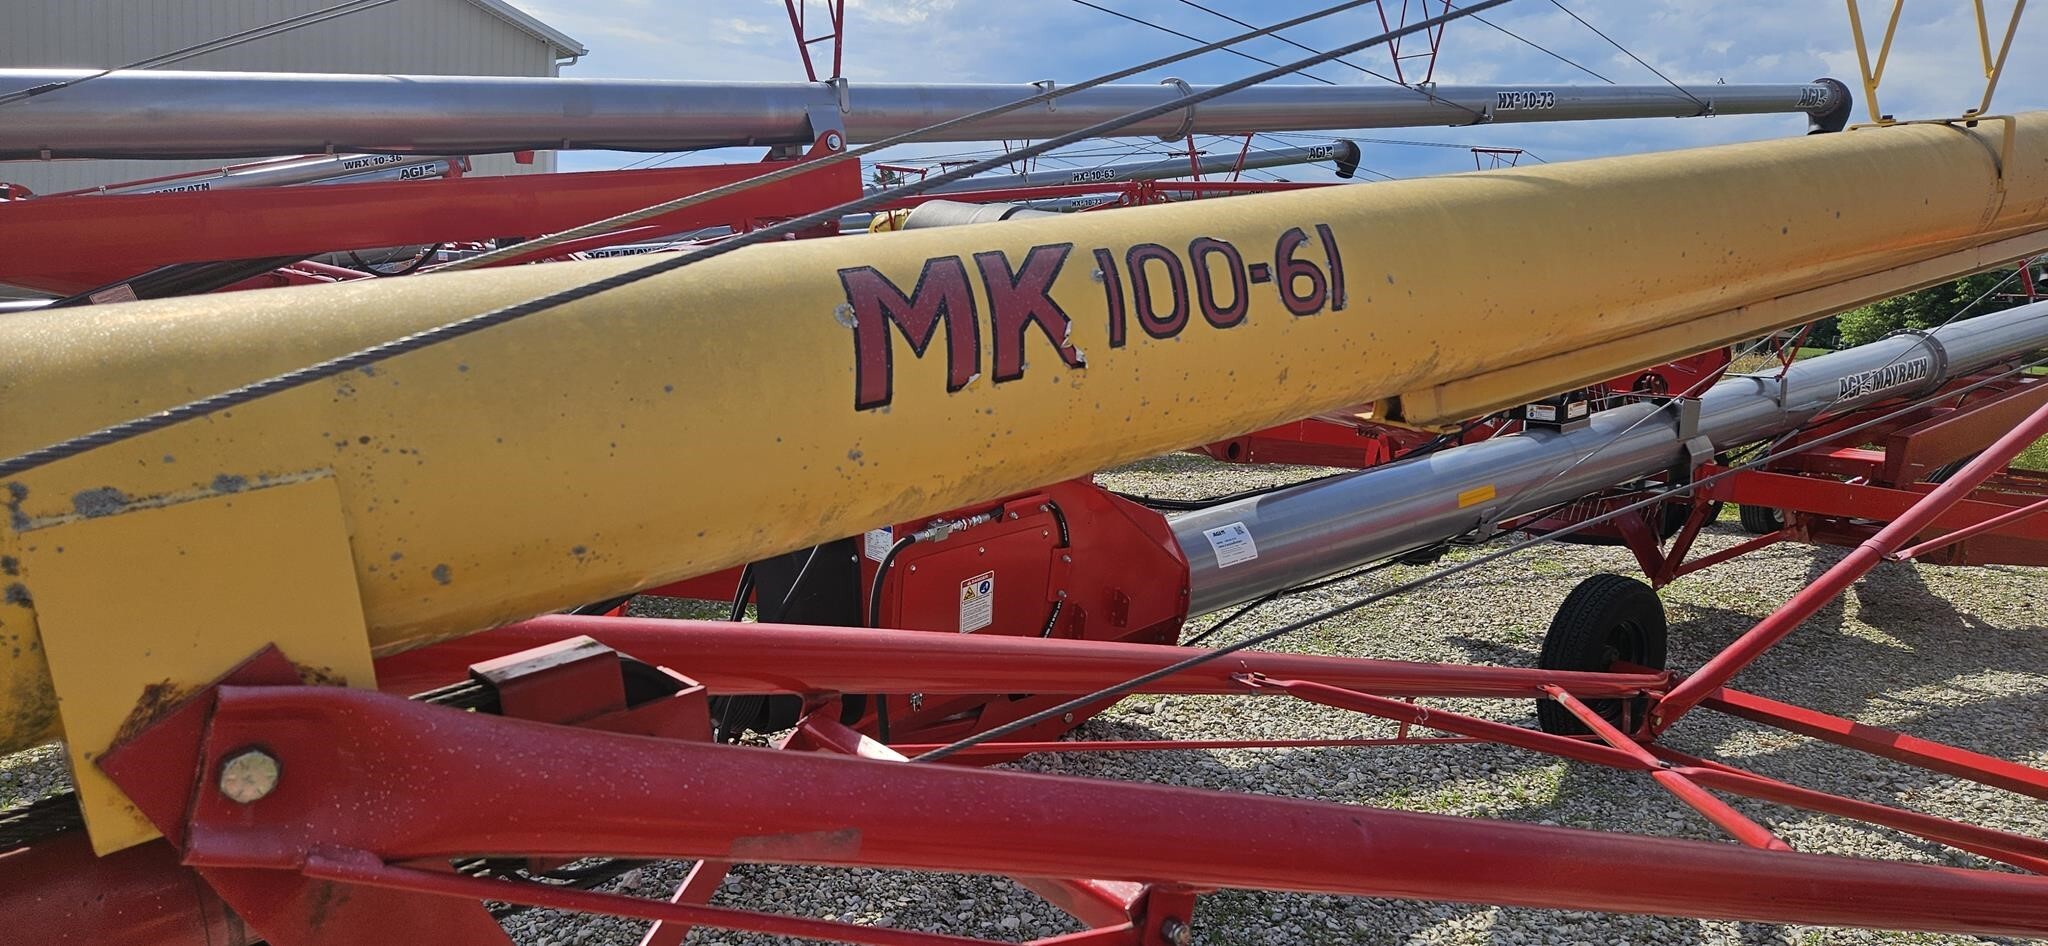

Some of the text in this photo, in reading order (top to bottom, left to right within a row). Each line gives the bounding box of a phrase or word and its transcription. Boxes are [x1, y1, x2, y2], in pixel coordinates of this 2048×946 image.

[1522, 91, 1555, 109] 10-73
[1308, 146, 1326, 159] AGI
[343, 154, 402, 170] WRX 10-36
[400, 166, 424, 180] AGI
[1091, 169, 1115, 181] 10-63
[837, 223, 1346, 411] MK 100-61
[1839, 357, 1928, 400] AGI MAYRATH
